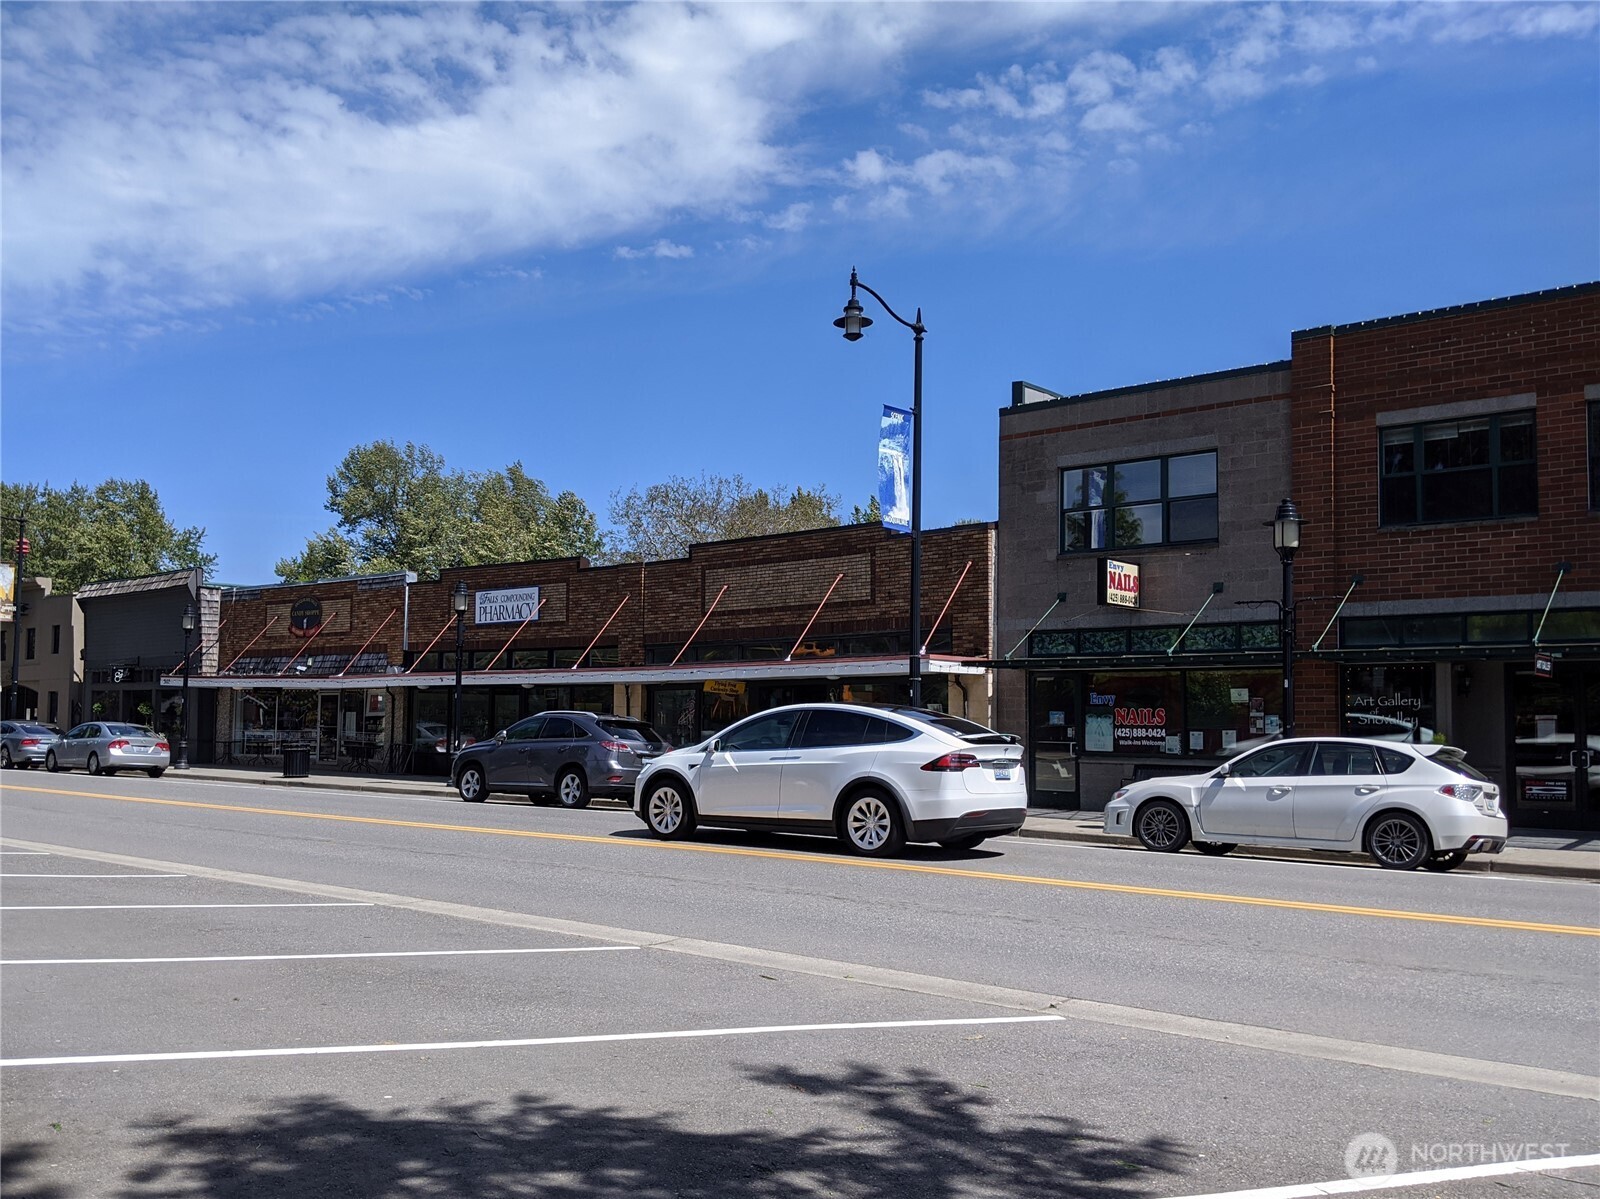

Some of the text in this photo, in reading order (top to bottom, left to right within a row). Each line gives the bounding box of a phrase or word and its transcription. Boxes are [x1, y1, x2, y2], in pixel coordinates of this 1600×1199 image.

[1109, 560, 1124, 572] Envy
[1109, 570, 1139, 593] NAILS
[479, 602, 535, 621] PHARMACY
[1090, 692, 1116, 706] Envy
[1354, 692, 1421, 711] Art Gallery
[1114, 708, 1166, 725] NAILS
